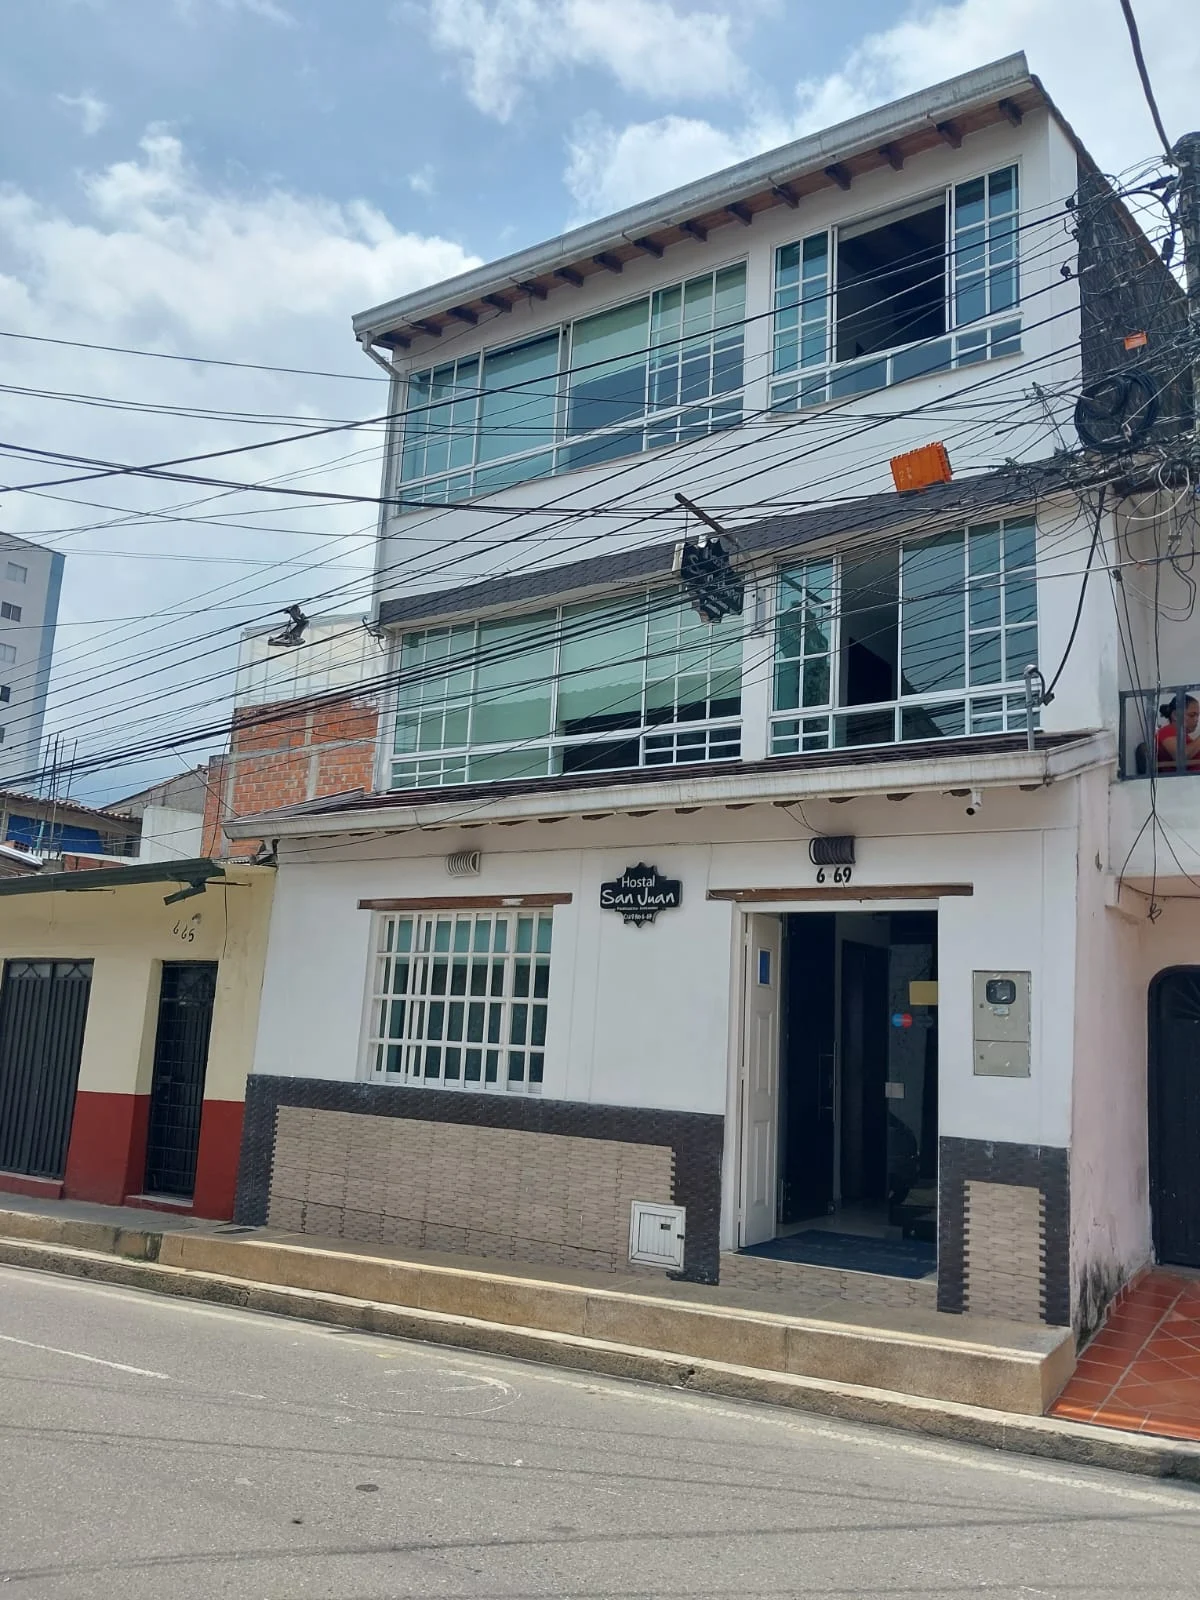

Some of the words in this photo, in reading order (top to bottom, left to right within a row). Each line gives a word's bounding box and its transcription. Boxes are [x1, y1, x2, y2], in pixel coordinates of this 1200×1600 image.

[621, 874, 656, 888] Hostal
[601, 889, 634, 905] San
[637, 887, 675, 906] Juan
